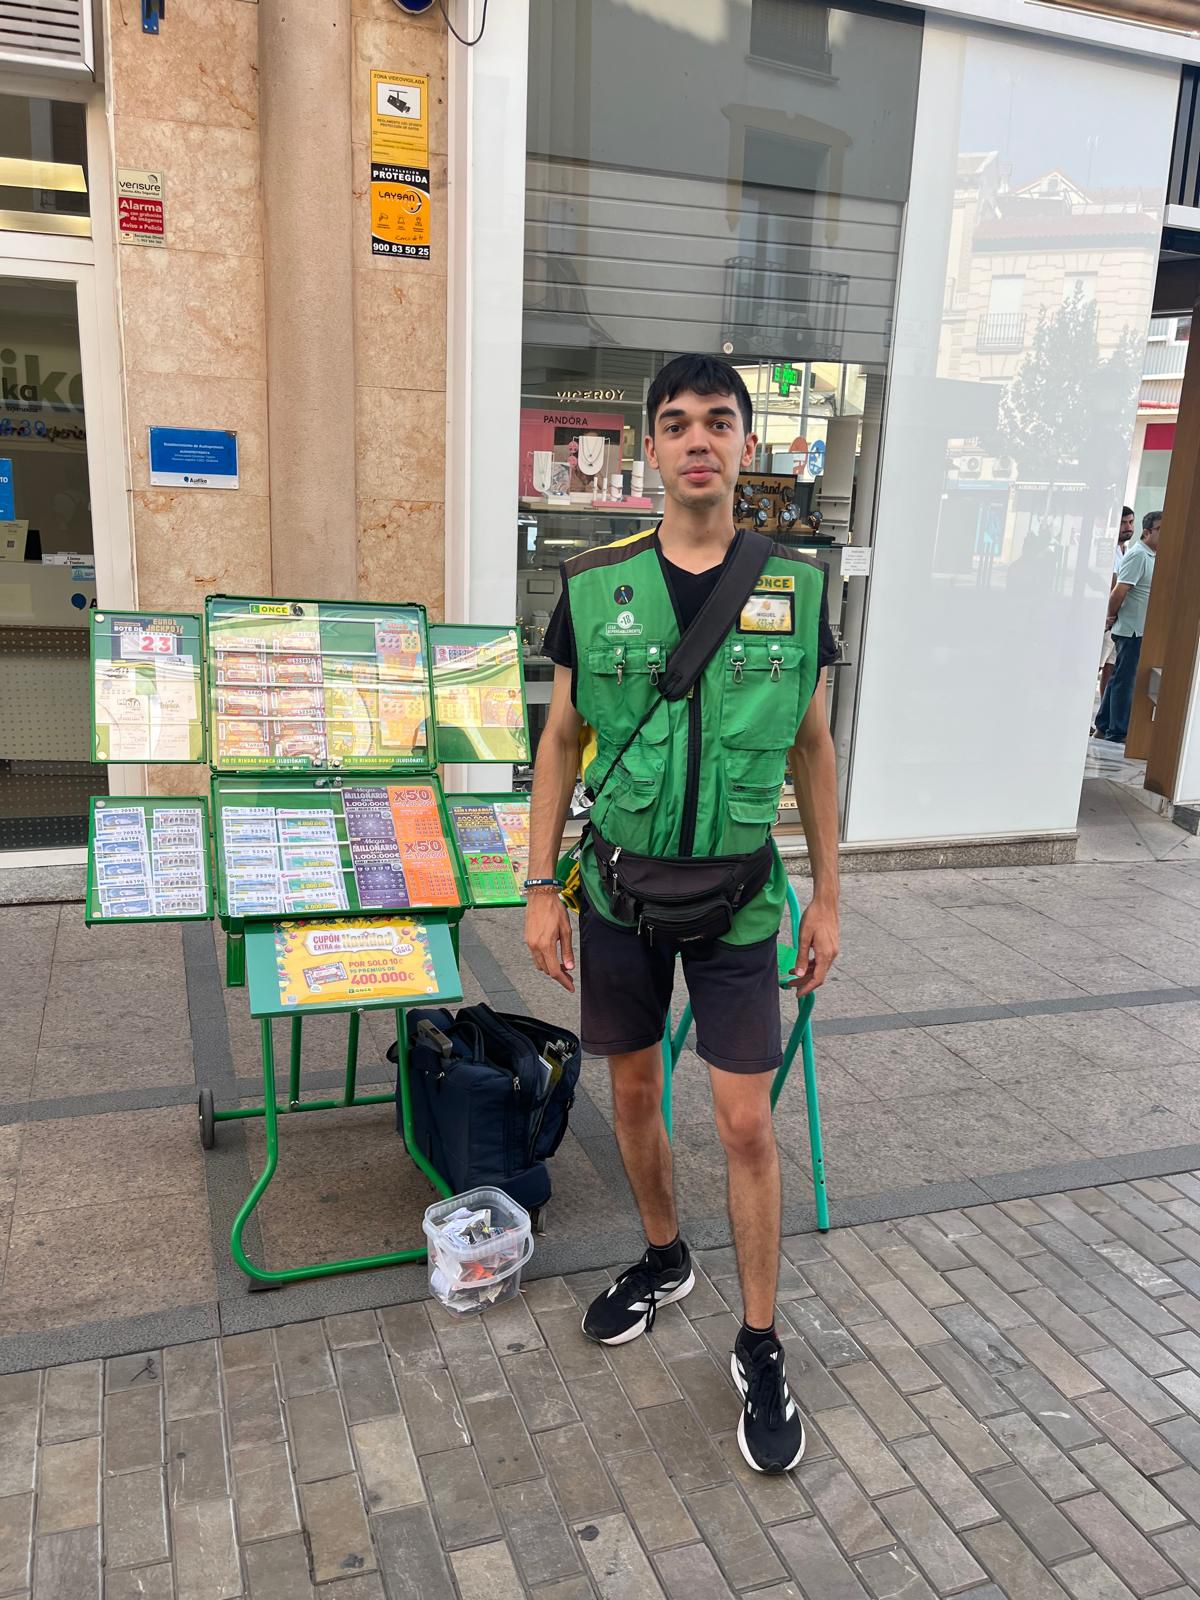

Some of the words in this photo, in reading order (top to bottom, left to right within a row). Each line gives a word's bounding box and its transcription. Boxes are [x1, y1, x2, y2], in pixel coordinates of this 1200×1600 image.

[388, 75, 425, 85] VIDEOVIGILADA
[373, 170, 428, 184] PROTEGIDA
[119, 181, 161, 192] verisure
[378, 190, 415, 202] LAYSAN
[120, 199, 162, 213] Alarma
[373, 243, 390, 252] 900
[391, 244, 403, 253] 83
[405, 246, 416, 254] 50
[418, 247, 429, 256] 25
[556, 389, 625, 403] VICEROY
[543, 415, 589, 426] PANDORA
[755, 578, 790, 589] ONCE
[261, 606, 288, 614] ONCE
[344, 791, 388, 800] MILLONARIO
[353, 843, 398, 852] MILLONARIO
[313, 933, 340, 944] CUPÓN
[313, 943, 333, 951] EXTRA
[349, 960, 365, 968] POR
[367, 959, 388, 967] SOLO
[351, 971, 415, 985] 400.000€
